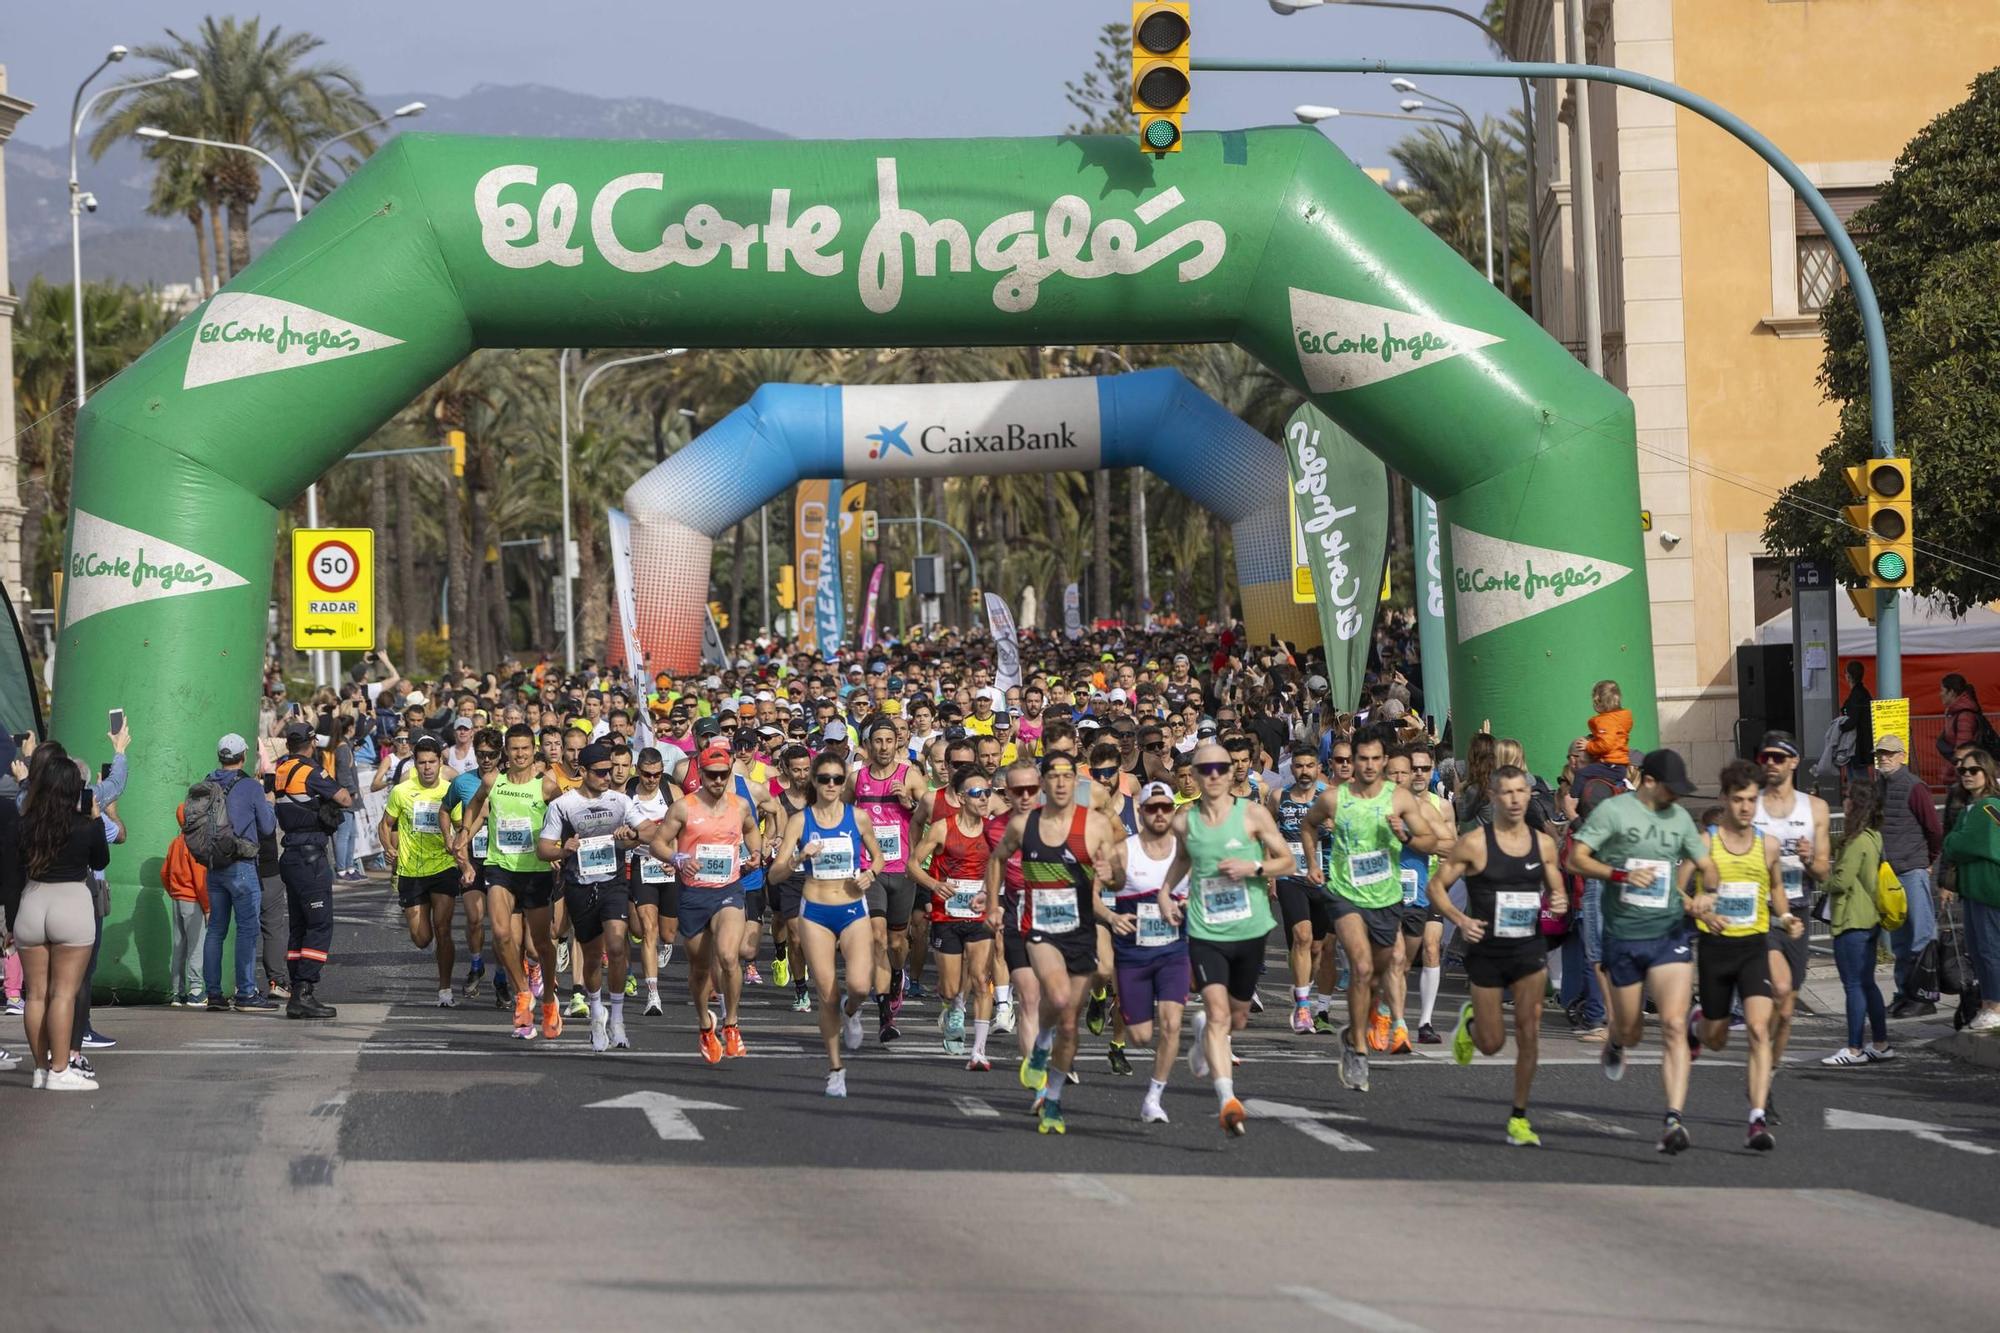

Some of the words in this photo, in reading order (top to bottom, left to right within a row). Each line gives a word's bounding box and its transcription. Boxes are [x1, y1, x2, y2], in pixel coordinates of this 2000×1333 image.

[473, 164, 583, 269] El
[591, 173, 844, 276] Corte
[858, 158, 1227, 314] Inglés
[200, 322, 221, 344] El
[221, 321, 275, 344] Corte
[277, 315, 361, 356] Inglés
[1298, 330, 1323, 354] El
[1322, 331, 1378, 355] Corte
[920, 421, 1078, 454] CaixaBank
[72, 552, 85, 578] El
[86, 553, 130, 578] Corte
[132, 548, 213, 589] Inglés
[320, 557, 348, 574] 50
[1456, 567, 1472, 592] El
[1472, 568, 1522, 592] Corte
[1524, 559, 1602, 600] Inglés
[310, 602, 356, 612] RADAR
[496, 788, 535, 800] LASANSI.COM
[425, 812, 436, 823] 16
[584, 810, 613, 821] milana
[506, 831, 523, 843] 282
[879, 838, 894, 849] 142
[589, 851, 607, 861] 445
[707, 859, 724, 870] 564
